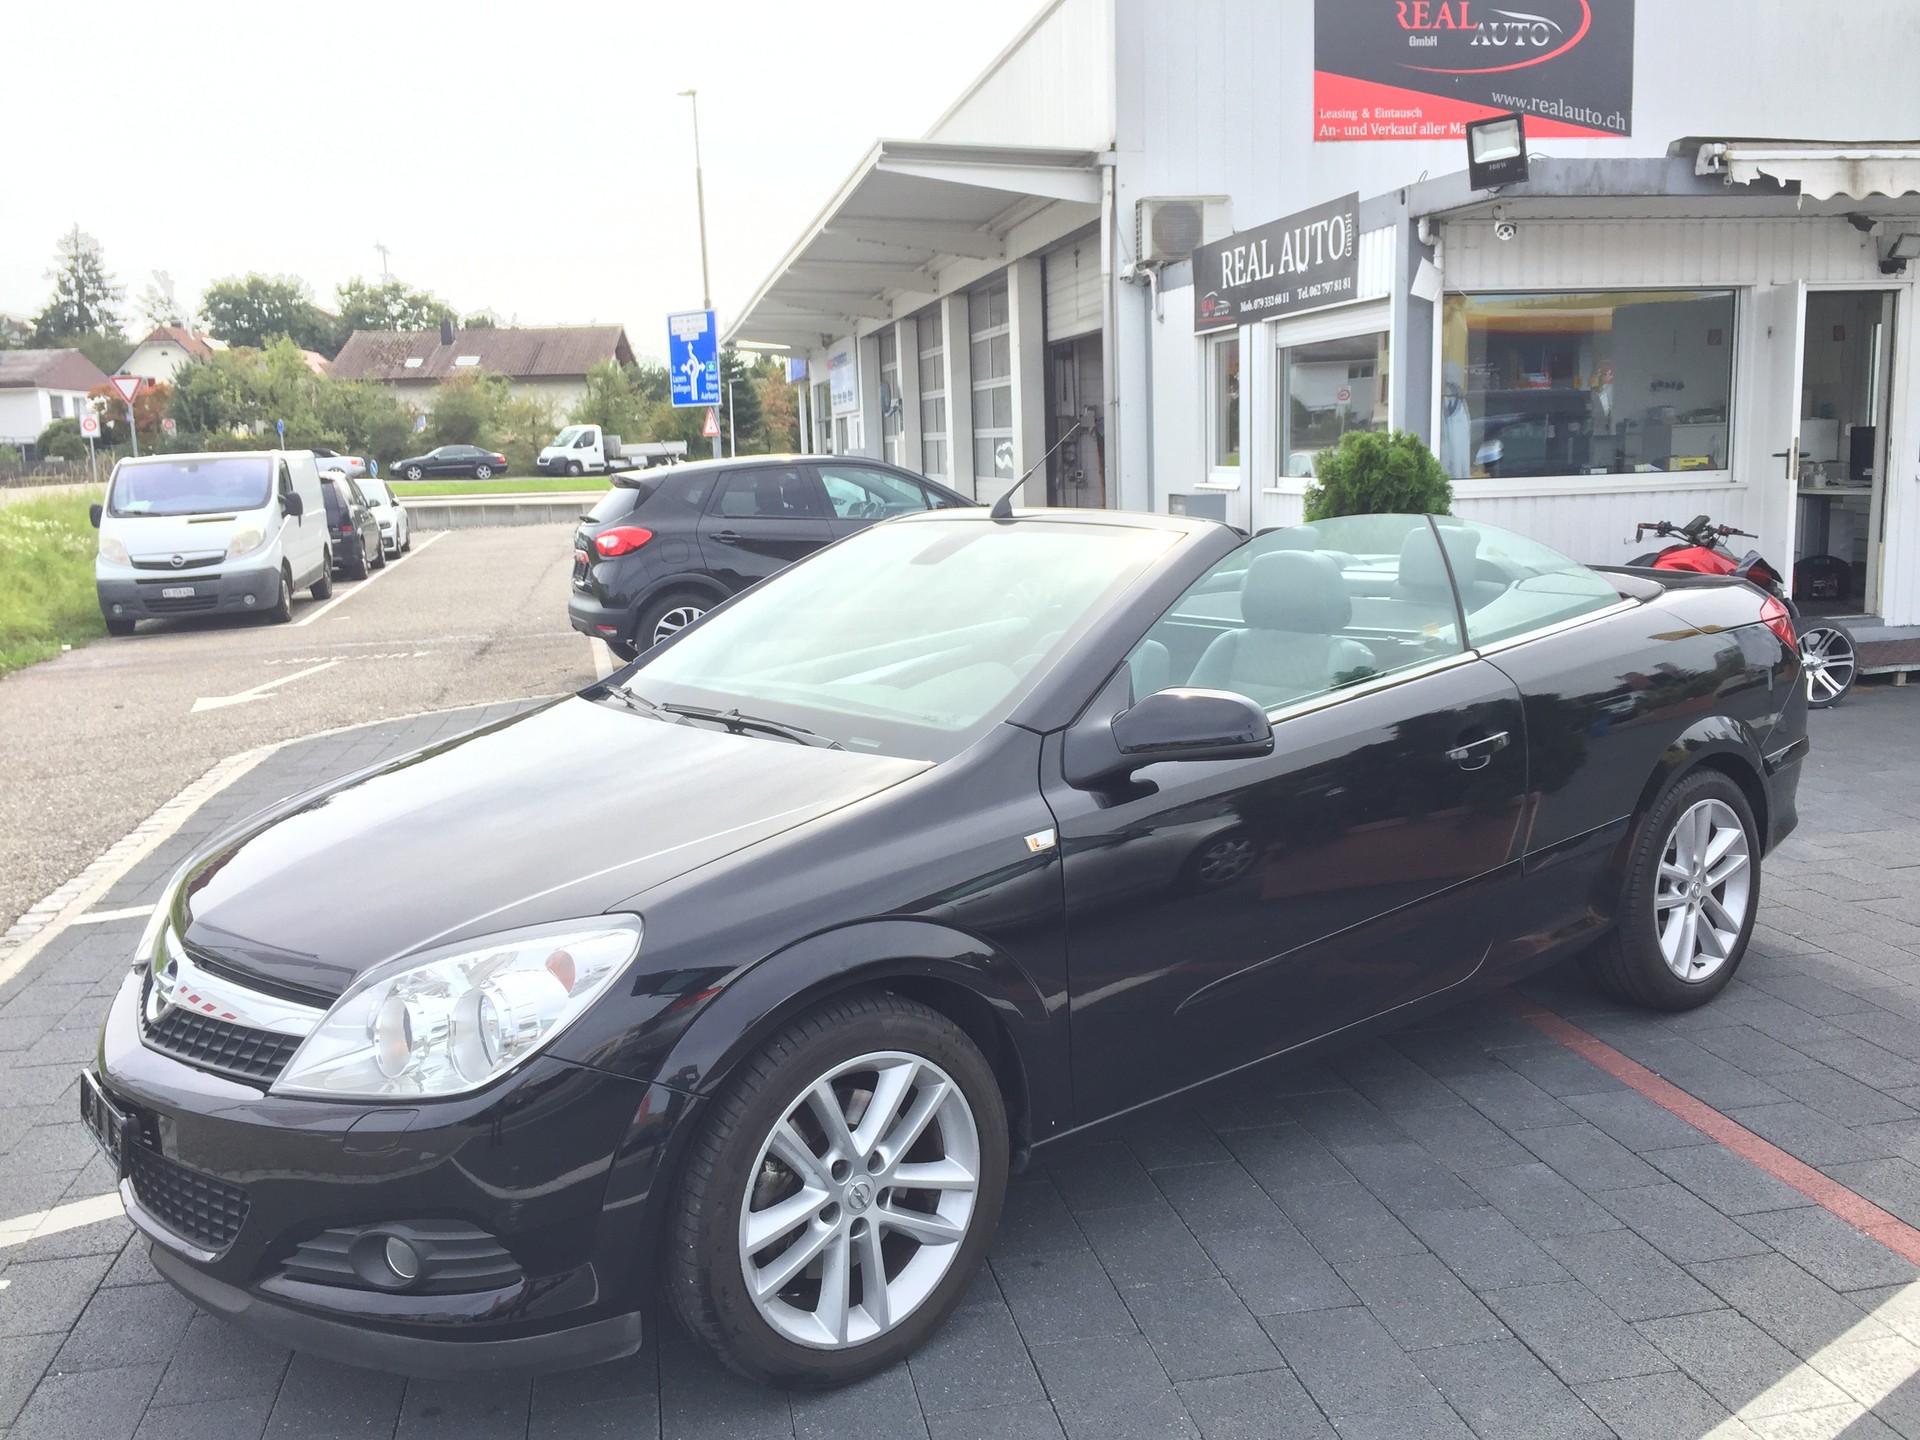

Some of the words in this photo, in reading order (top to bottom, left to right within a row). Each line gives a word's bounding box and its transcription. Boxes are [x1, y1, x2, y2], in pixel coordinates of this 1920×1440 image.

[1395, 0, 1479, 30] REAL
[1408, 35, 1438, 47] GmbH
[1470, 22, 1550, 46] AUTO
[1319, 107, 1358, 121] Leasing
[1362, 107, 1370, 119] &
[1374, 106, 1422, 119] Eintausch
[1491, 89, 1627, 131] www.realauto.ch
[1319, 123, 1341, 136] An-
[1344, 122, 1368, 136] und
[1370, 122, 1418, 136] Verkauf
[1419, 121, 1447, 135] aller
[1344, 212, 1352, 257] GmbH
[1220, 238, 1274, 289] REAL
[1279, 215, 1346, 275] AUTO
